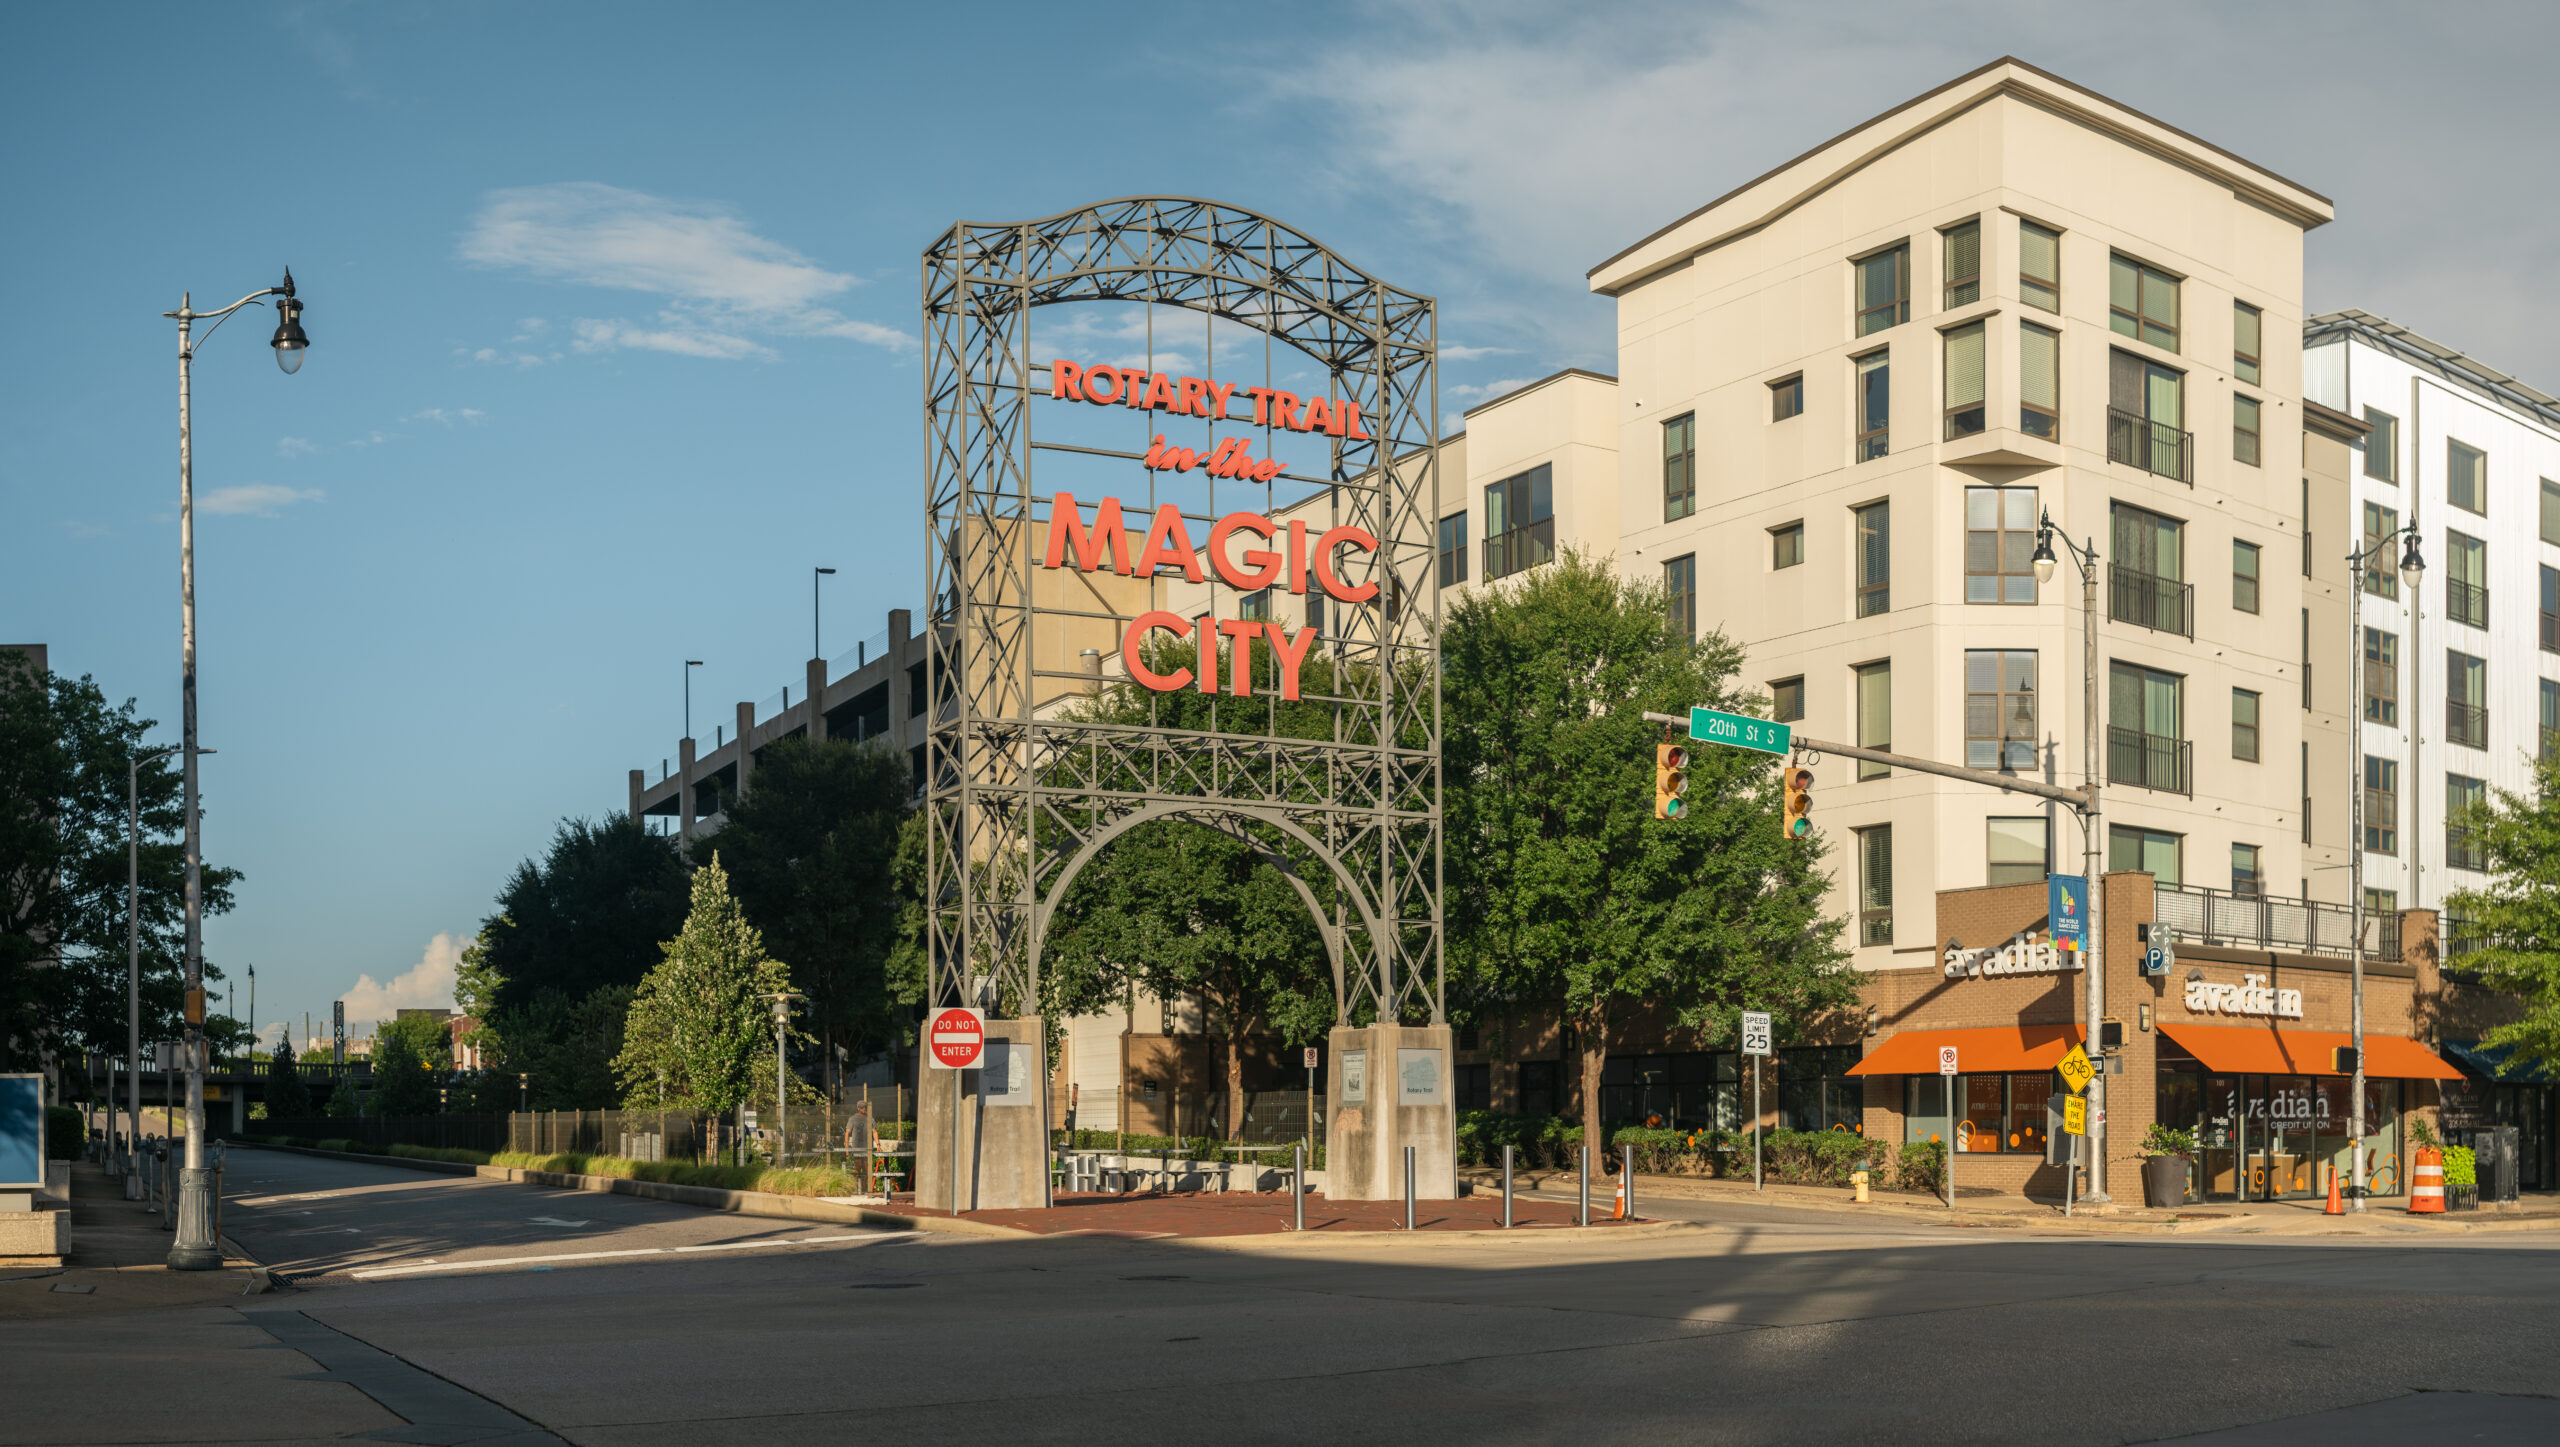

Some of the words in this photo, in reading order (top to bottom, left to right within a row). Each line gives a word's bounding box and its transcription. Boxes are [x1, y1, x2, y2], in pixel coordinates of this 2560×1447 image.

[1052, 360, 1236, 420] ROTARY
[1247, 386, 1368, 440] TRAIL
[1144, 434, 1211, 473] in
[1205, 437, 1289, 482] the
[1042, 492, 1379, 602] MAGIC
[1121, 611, 1318, 701] CITY
[1708, 718, 1737, 738] 20th
[1746, 725, 1759, 742] St
[1767, 729, 1775, 744] S
[938, 1020, 951, 1030] DO
[956, 1020, 975, 1030] NOT
[1745, 1016, 1768, 1024] SPEED
[1747, 1025, 1766, 1033] LIMIT
[1746, 1033, 1768, 1049] 25
[941, 1046, 972, 1056] ENTER
[2067, 1099, 2083, 1110] SHARE
[2070, 1111, 2080, 1120] THE
[2067, 1121, 2081, 1131] ROAD
[2270, 1121, 2300, 1130] CREDIT
